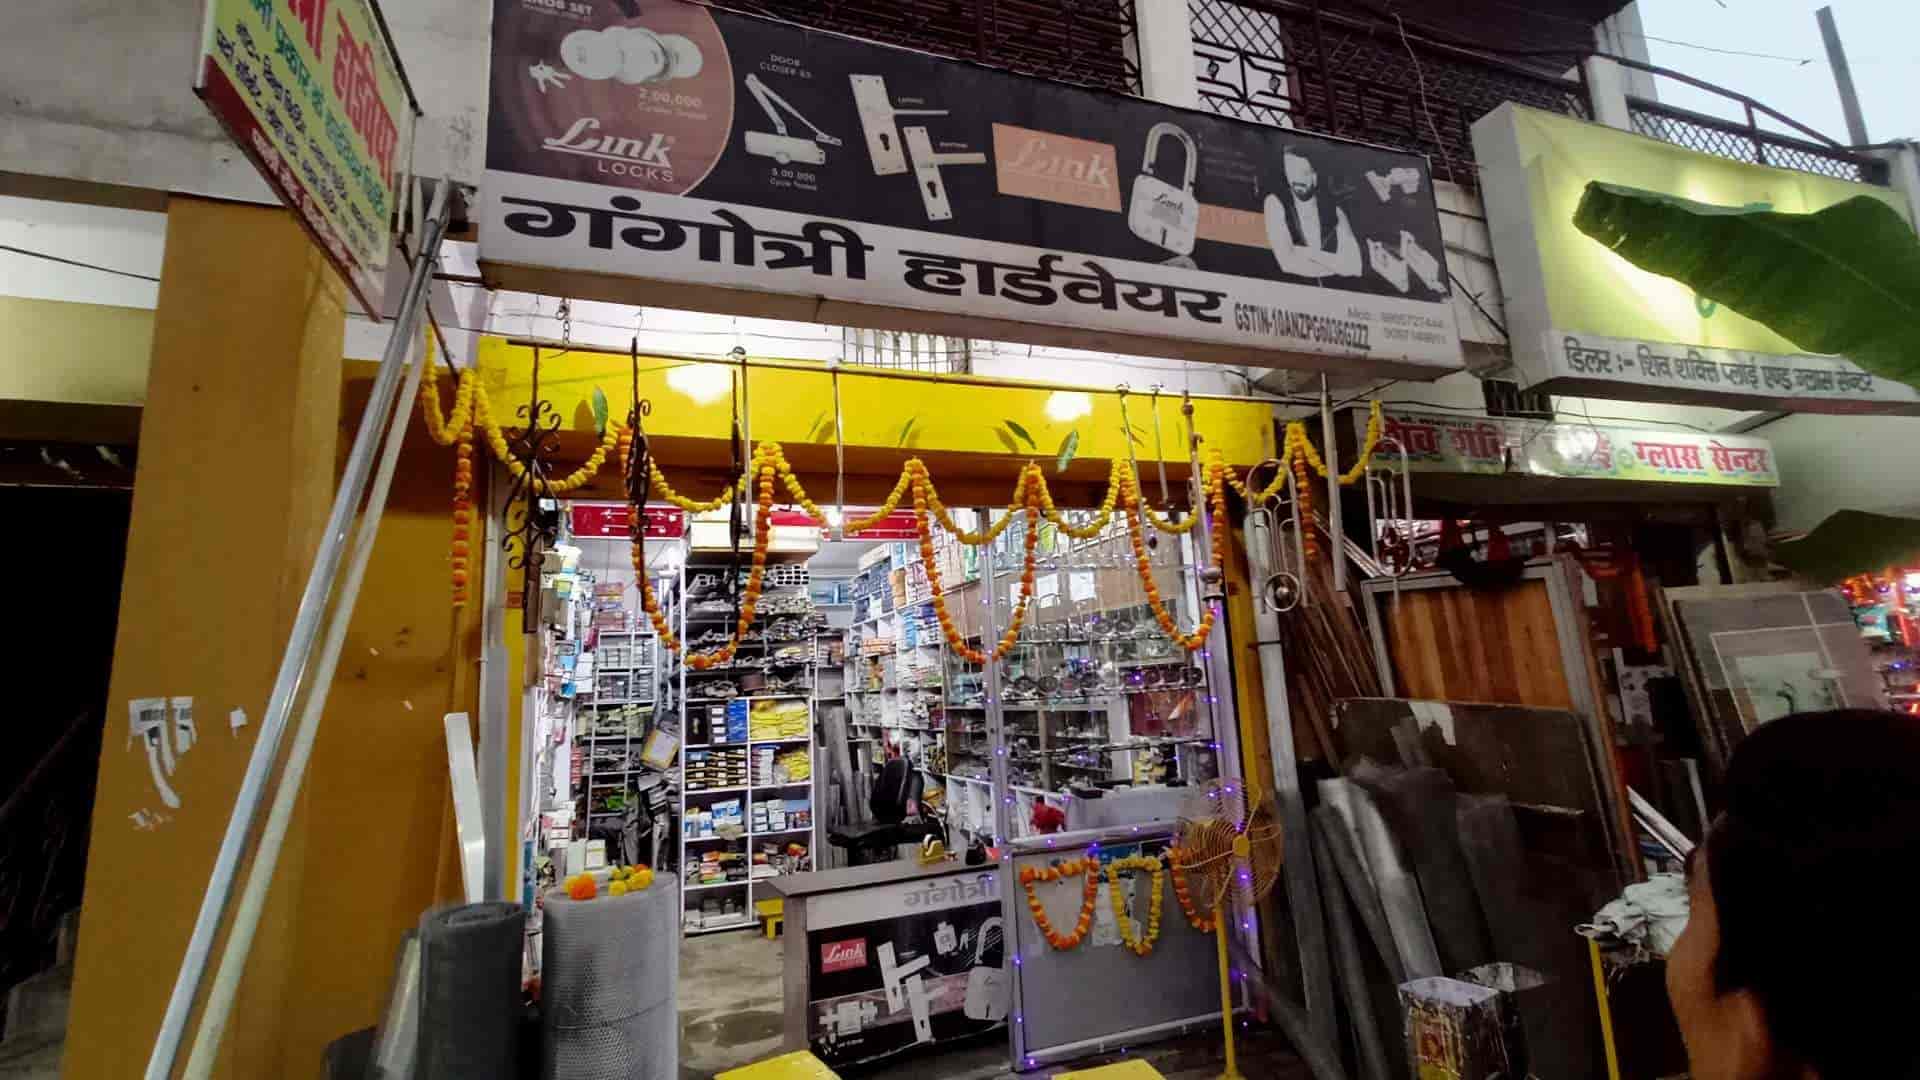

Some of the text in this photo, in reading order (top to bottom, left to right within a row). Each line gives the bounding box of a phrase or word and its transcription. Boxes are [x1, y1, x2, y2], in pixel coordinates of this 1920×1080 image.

[569, 3, 593, 15] SET
[543, 117, 673, 168] Link
[1004, 138, 1111, 189] Link
[596, 160, 674, 183] LOCKS
[501, 195, 1227, 323] गंगोत्री हार्डवेयर
[1632, 441, 1704, 470] ग्लास
[1707, 439, 1770, 473] सेन्टर
